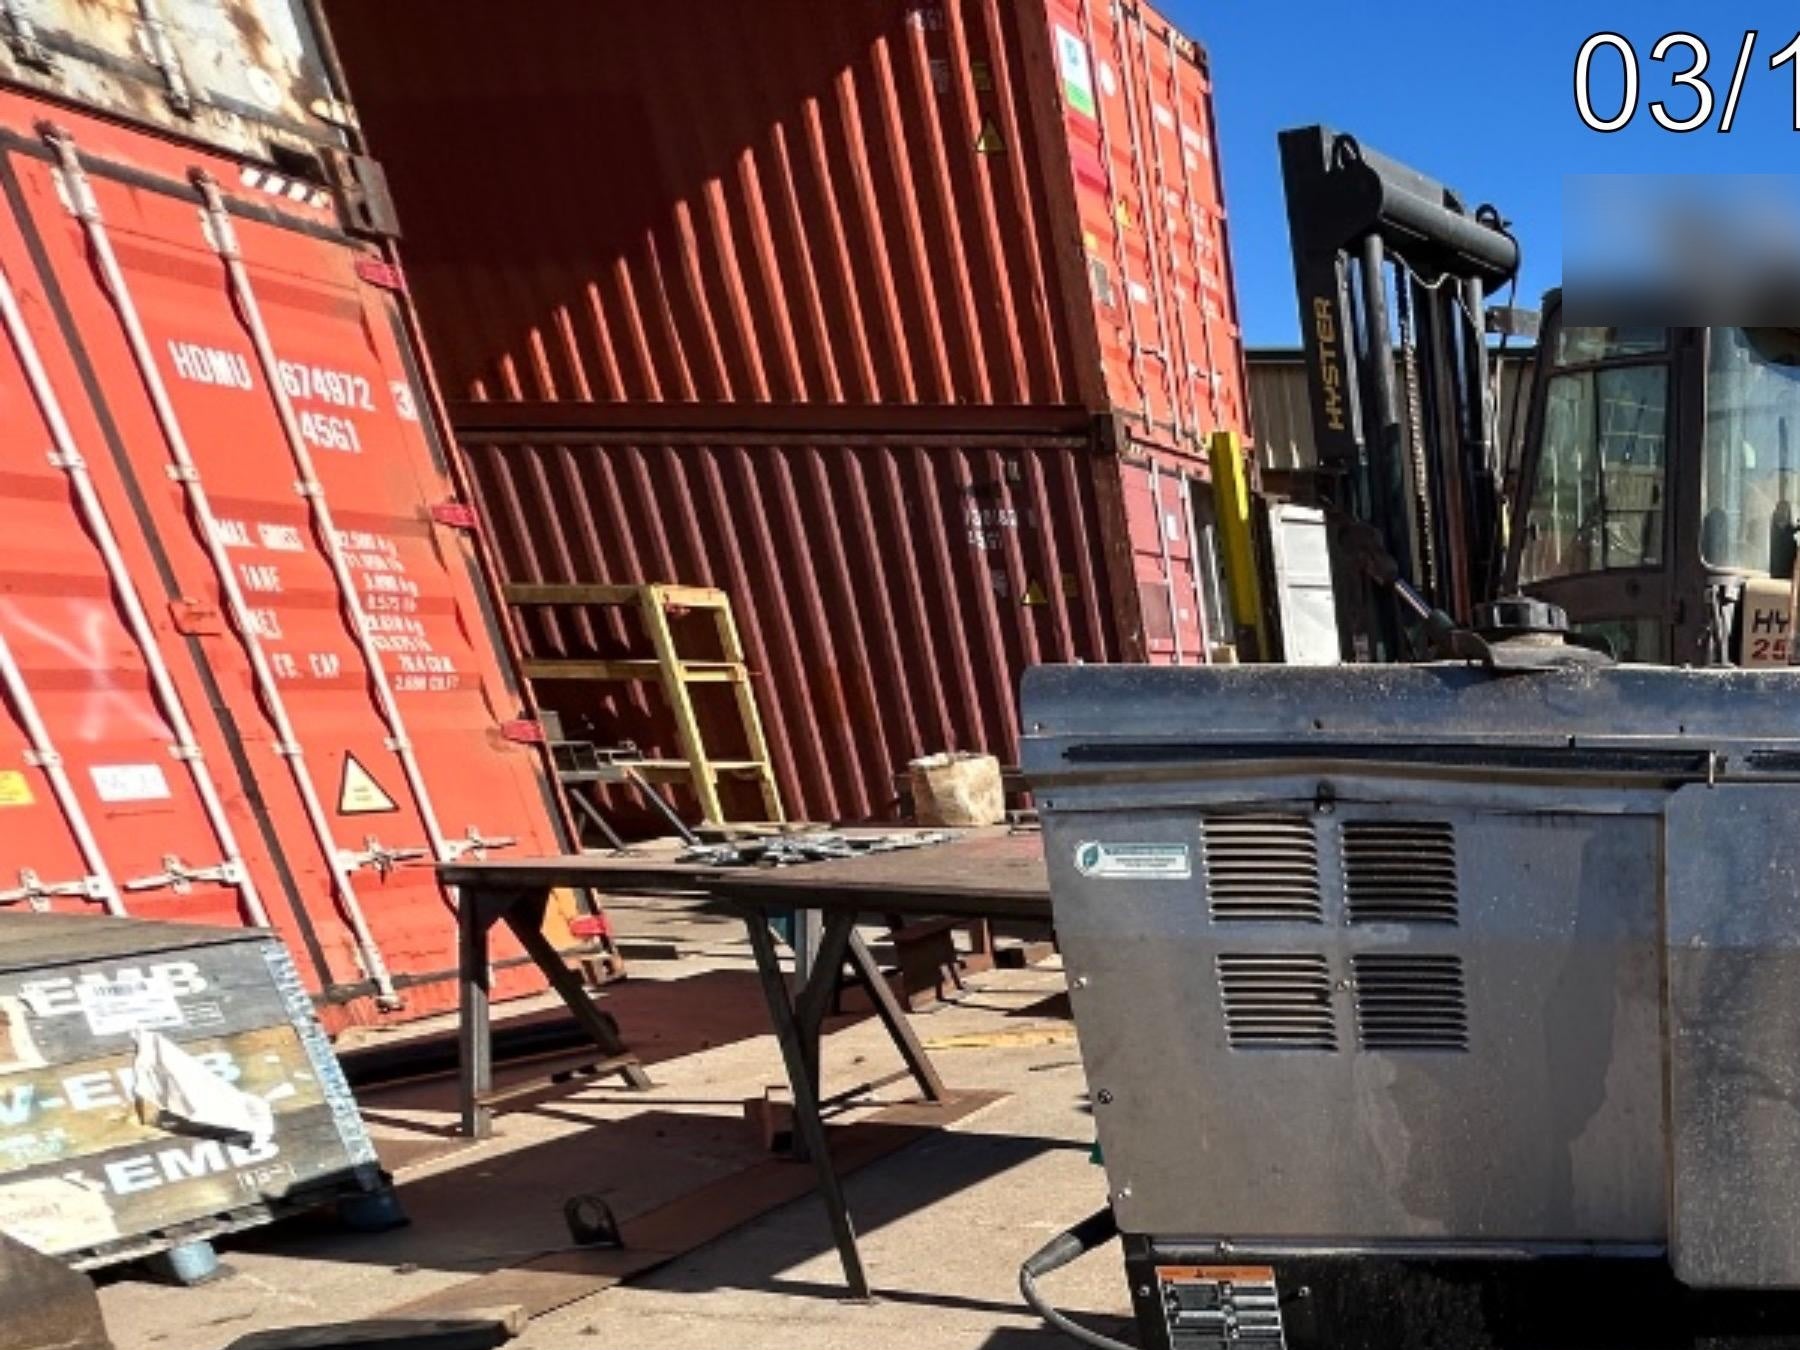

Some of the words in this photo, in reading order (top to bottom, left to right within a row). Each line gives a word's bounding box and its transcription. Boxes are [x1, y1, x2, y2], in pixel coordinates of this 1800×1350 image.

[167, 338, 253, 391] HDMU
[278, 359, 377, 412] 674972
[388, 380, 420, 422] 3
[1313, 296, 1345, 431] HYSTER
